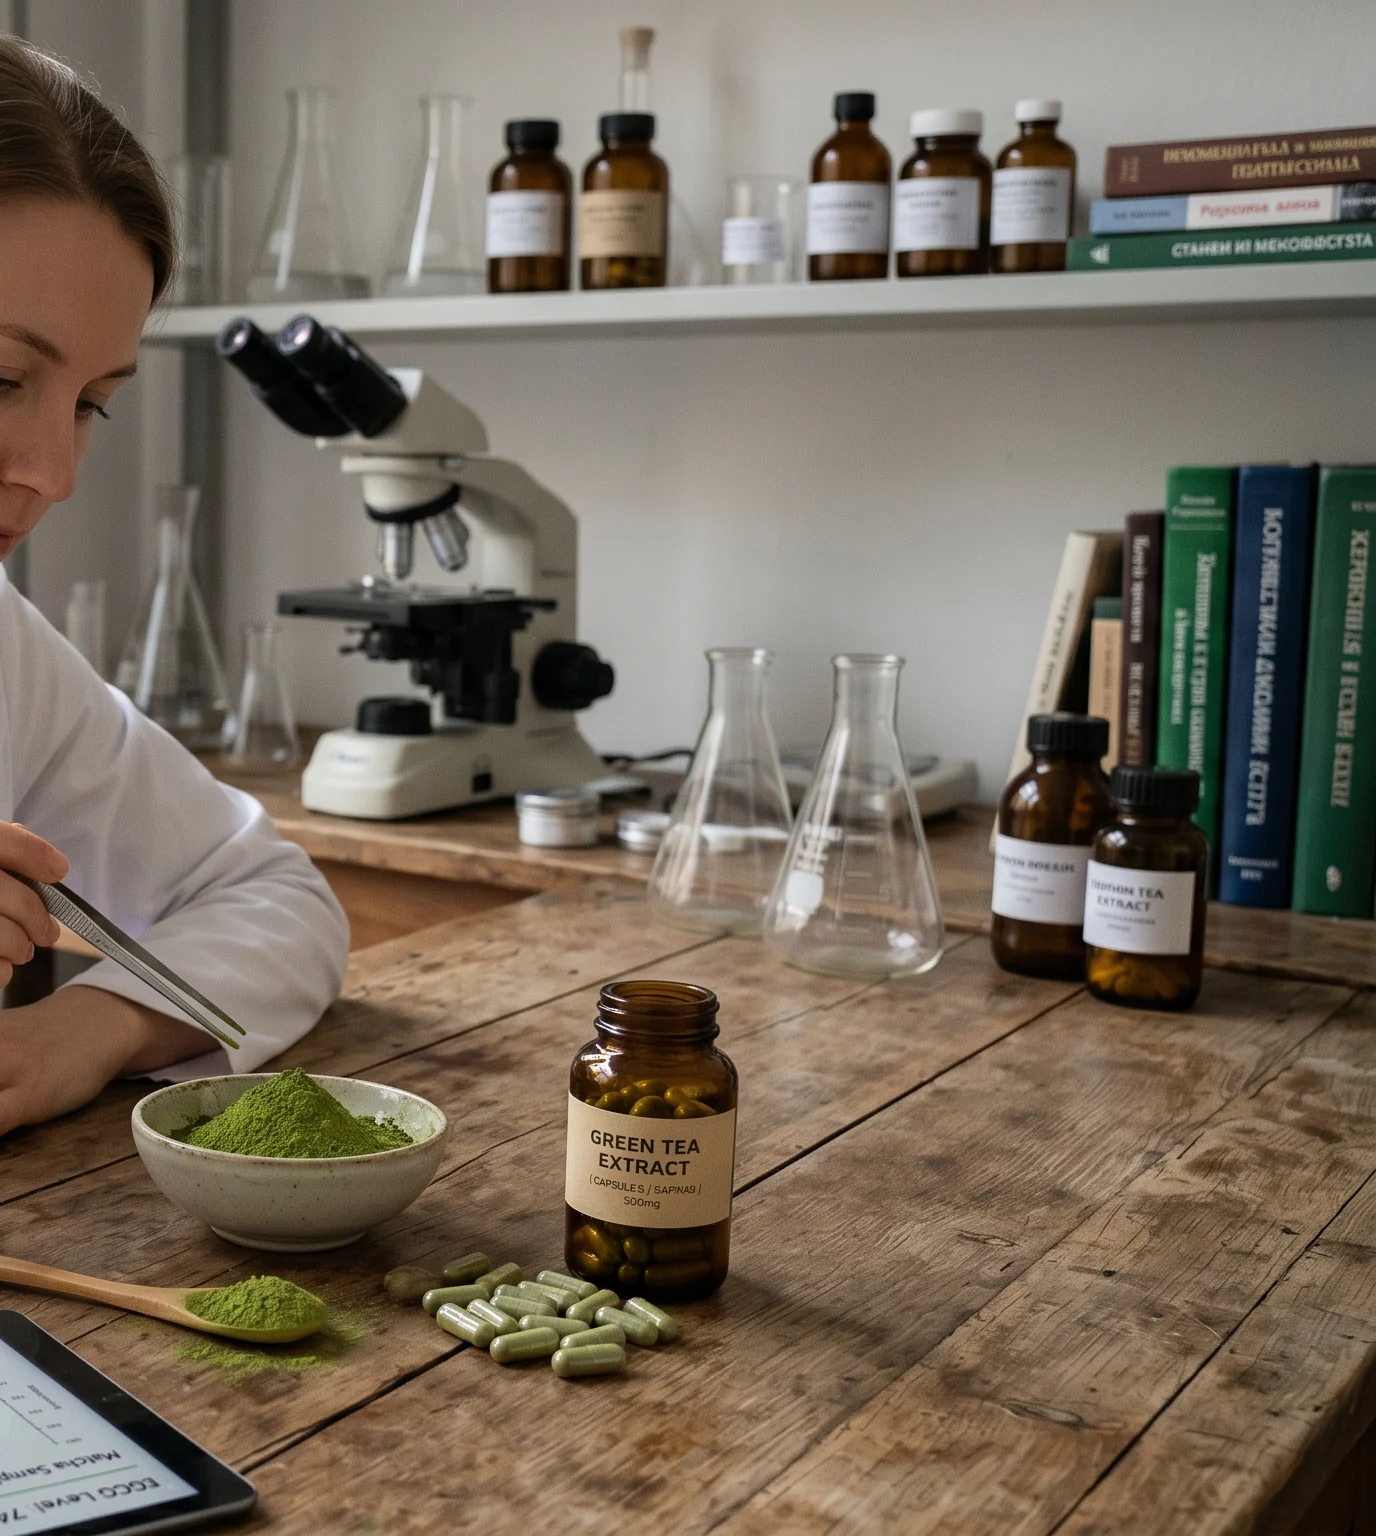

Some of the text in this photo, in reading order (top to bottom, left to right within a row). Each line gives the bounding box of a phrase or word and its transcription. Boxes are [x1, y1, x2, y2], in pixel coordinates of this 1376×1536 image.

[1138, 886, 1164, 900] TEA
[1097, 895, 1151, 912] EXTRACT
[590, 1129, 701, 1155] GREEN TEA
[598, 1152, 691, 1176] EXTRACT
